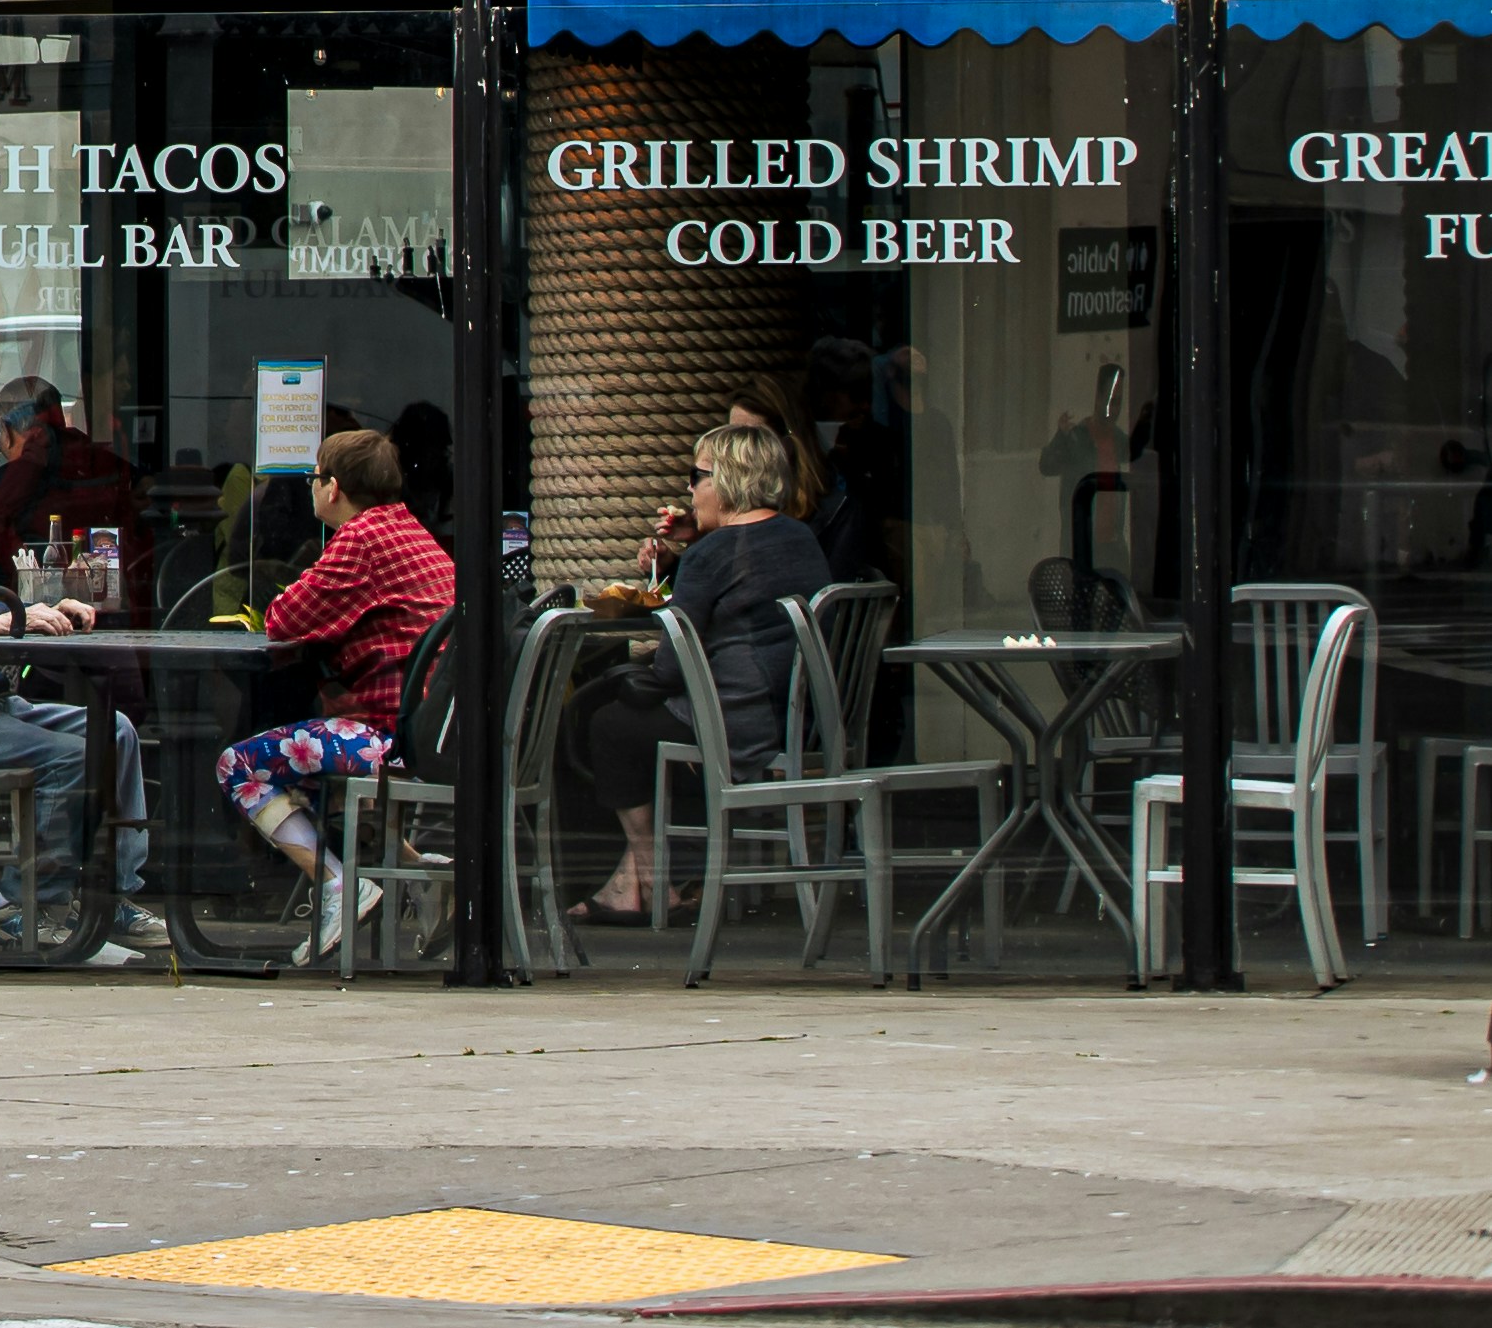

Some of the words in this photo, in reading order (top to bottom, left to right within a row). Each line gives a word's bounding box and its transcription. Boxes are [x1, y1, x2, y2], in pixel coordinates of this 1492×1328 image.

[71, 143, 286, 194] TACOS
[547, 139, 846, 191] GRILLED
[867, 136, 1138, 189] SHRIMP
[120, 223, 241, 269] BAR
[666, 219, 843, 265] COLD
[861, 218, 1021, 263] BEER
[1424, 214, 1492, 259] FU
